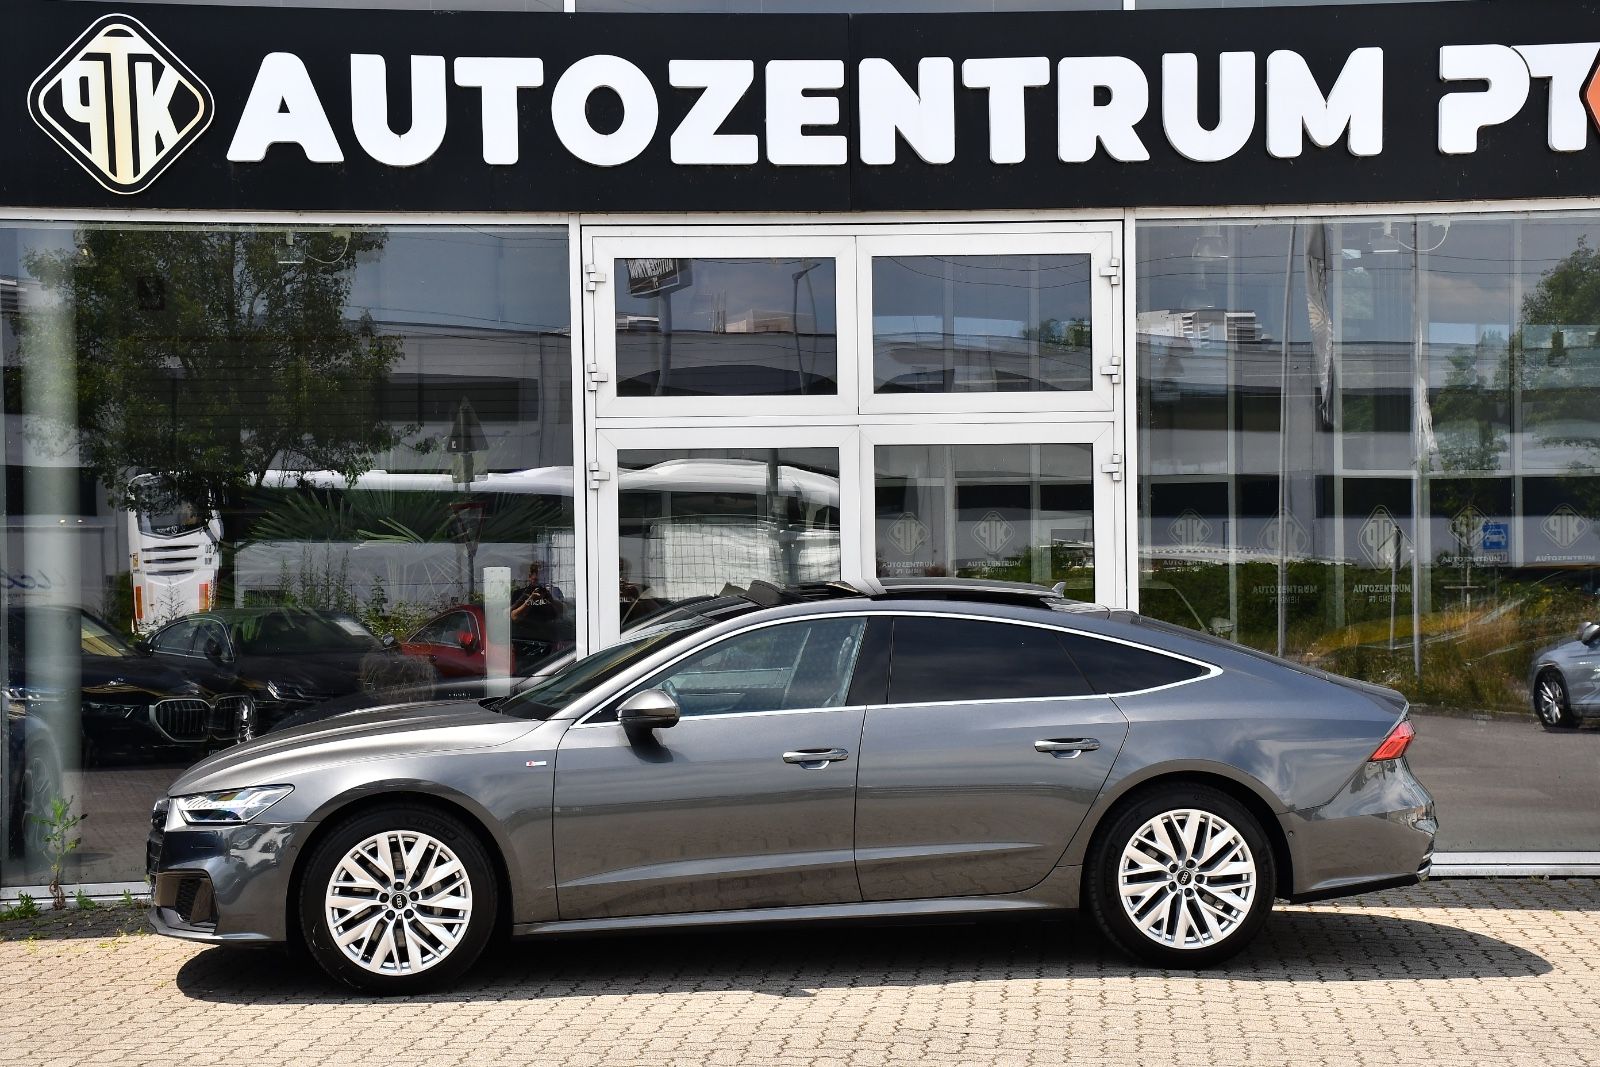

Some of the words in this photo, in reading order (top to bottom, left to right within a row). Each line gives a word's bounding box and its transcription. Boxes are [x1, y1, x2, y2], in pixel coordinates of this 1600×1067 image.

[61, 35, 184, 186] PTK
[226, 47, 1384, 167] AUTOZENTRUM
[1438, 42, 1600, 154] PT
[1352, 584, 1411, 593] AUTOZENTRUM
